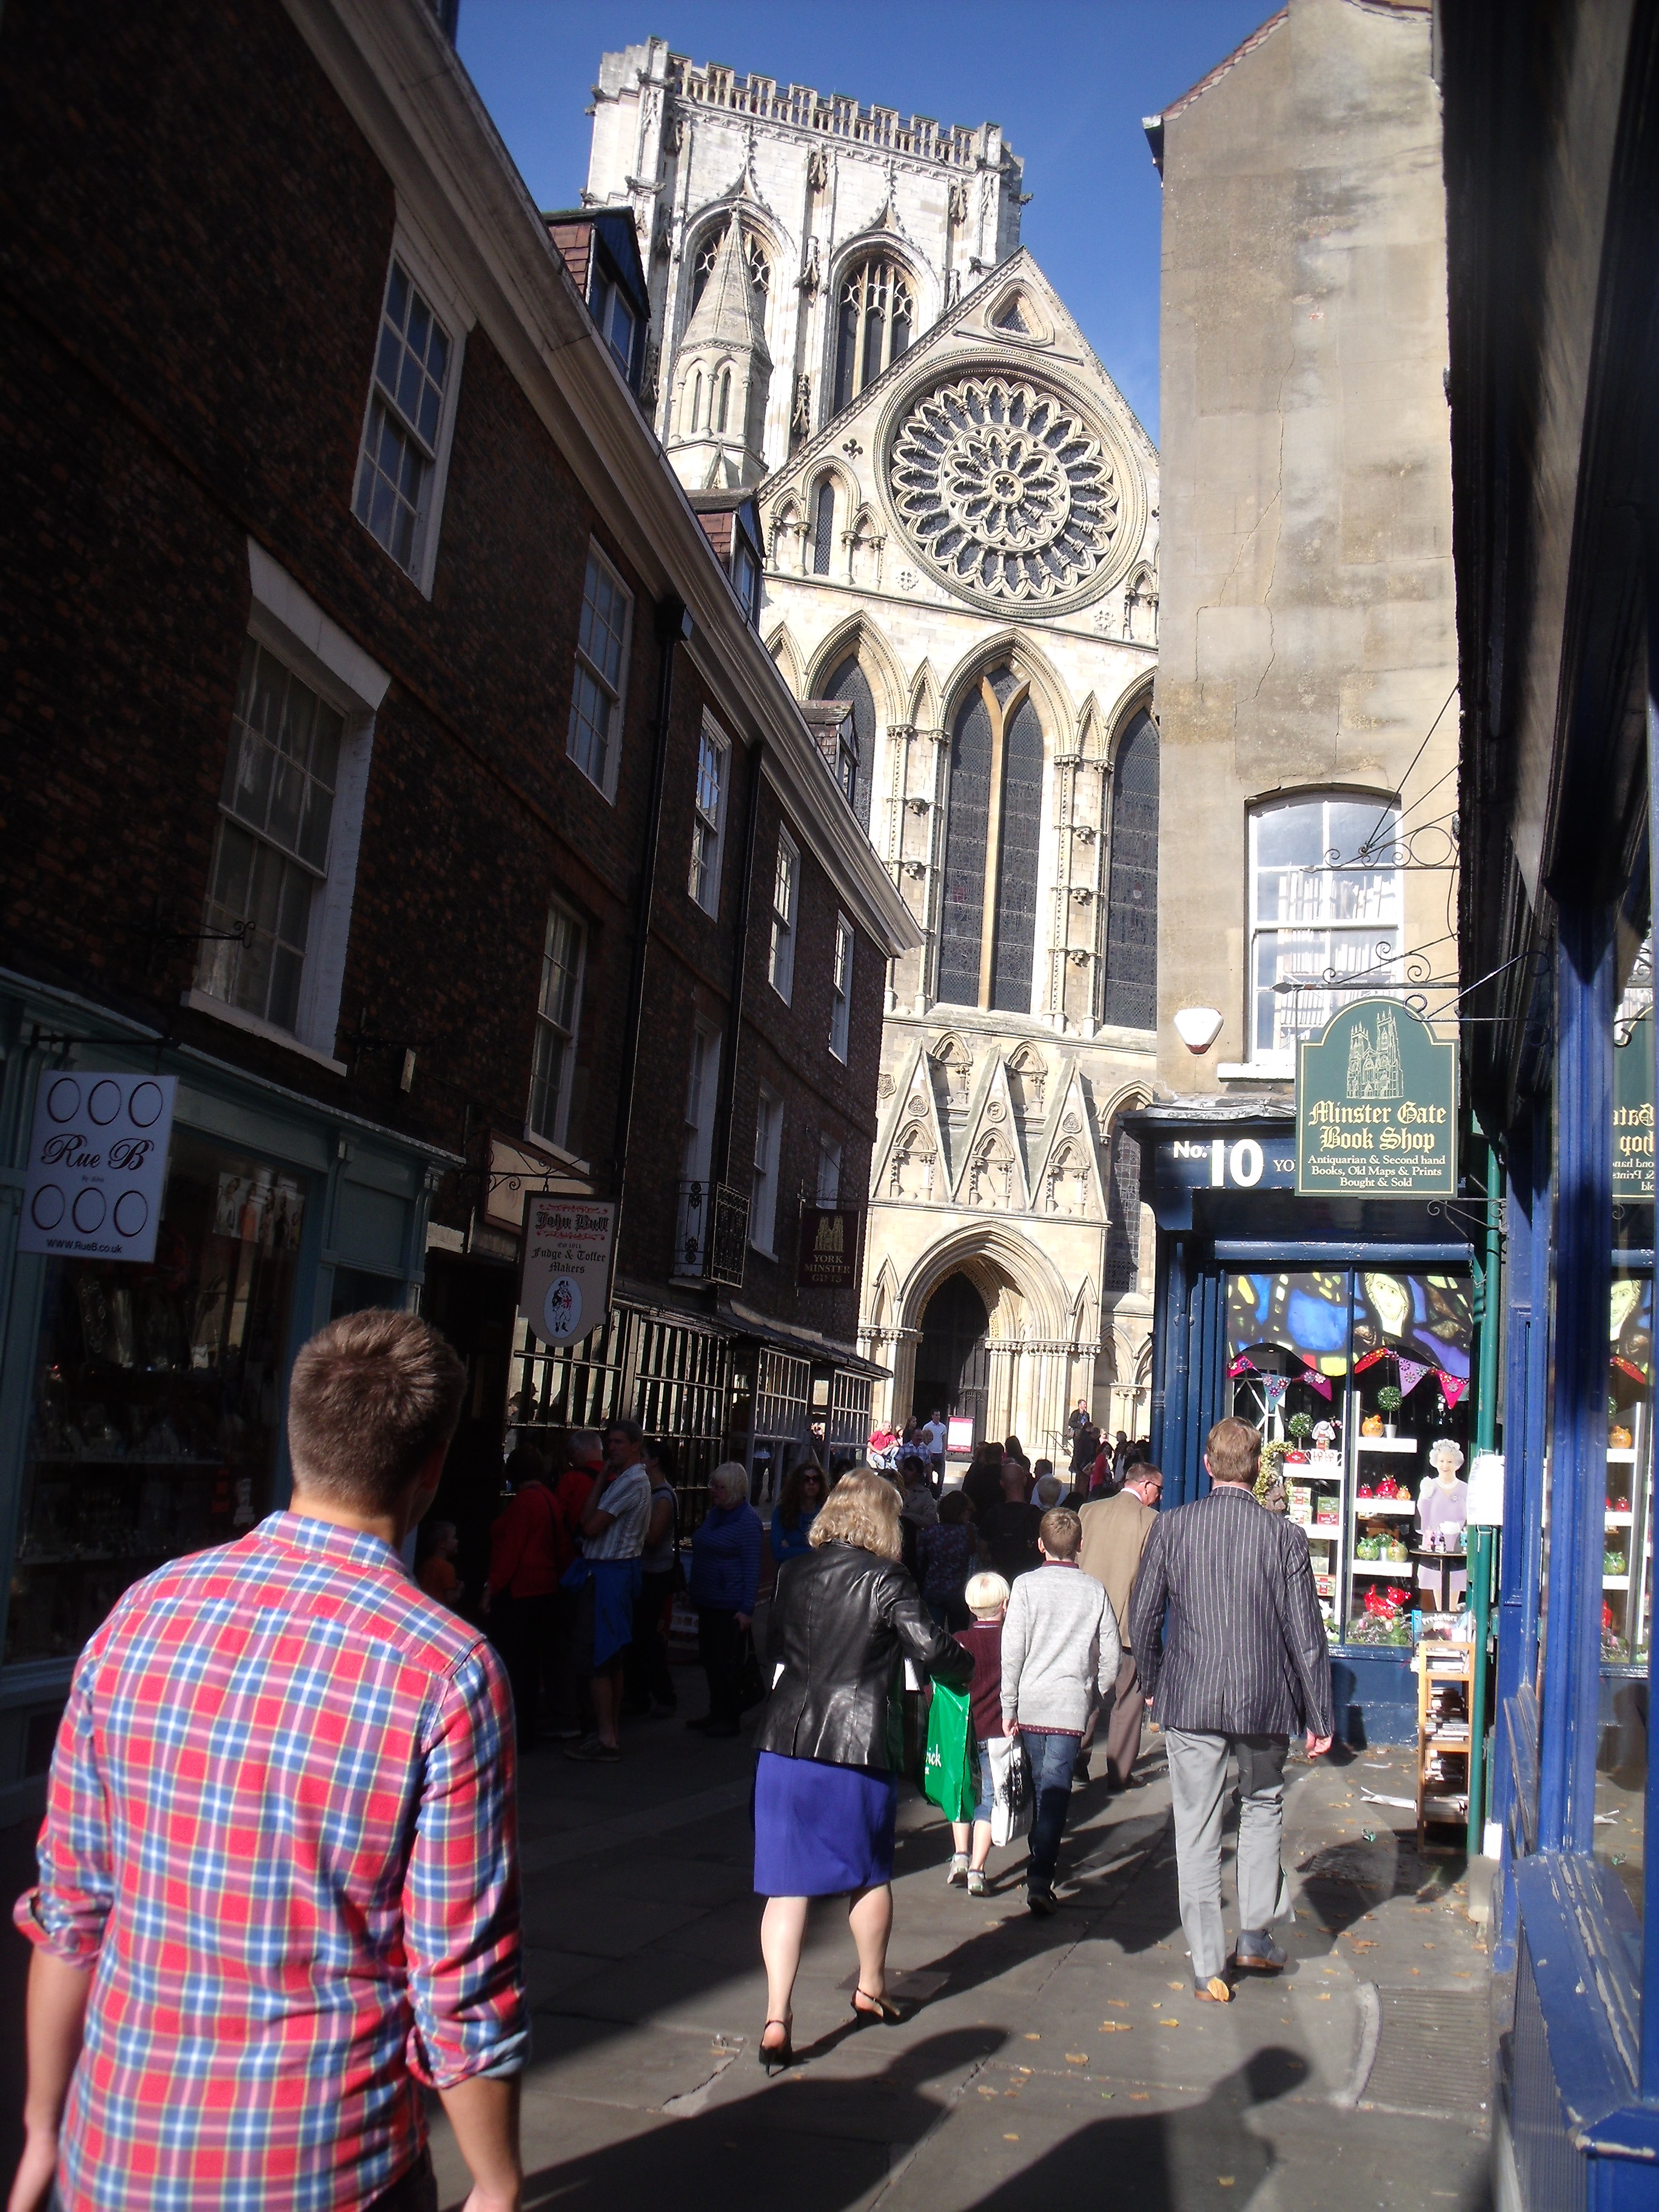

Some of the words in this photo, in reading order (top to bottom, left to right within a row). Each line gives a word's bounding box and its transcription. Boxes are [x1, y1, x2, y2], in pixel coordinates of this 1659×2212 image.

[1309, 1100, 1392, 1126] Minster
[1397, 1101, 1447, 1124] Gate
[1319, 1126, 1374, 1151] Book
[1379, 1127, 1435, 1153] Shop
[41, 1134, 100, 1168] Rue
[108, 1138, 155, 1170] B
[1173, 1141, 1208, 1158] No.
[1212, 1139, 1264, 1187] 10
[1273, 1159, 1295, 1172] YO
[1308, 1155, 1366, 1166] Antiquarian
[1369, 1155, 1380, 1164] &
[1383, 1155, 1418, 1164] Second
[1421, 1155, 1446, 1164] hand
[1312, 1166, 1346, 1176] Books,
[1348, 1166, 1366, 1175] Old
[1368, 1167, 1396, 1177] Maps
[1398, 1167, 1409, 1176] &
[1412, 1167, 1442, 1176] Prints
[1340, 1178, 1375, 1188] Bought
[1377, 1178, 1389, 1187] &
[1391, 1178, 1412, 1187] Sold
[535, 1212, 572, 1230] John
[575, 1214, 609, 1232] Bull
[531, 1248, 561, 1260] Fudge
[565, 1249, 573, 1259] &
[577, 1250, 606, 1262] Toffee
[813, 1255, 843, 1263] YORK
[549, 1261, 585, 1273] Makers
[805, 1264, 850, 1273] MINSTER
[813, 1274, 842, 1282] GIFTS
